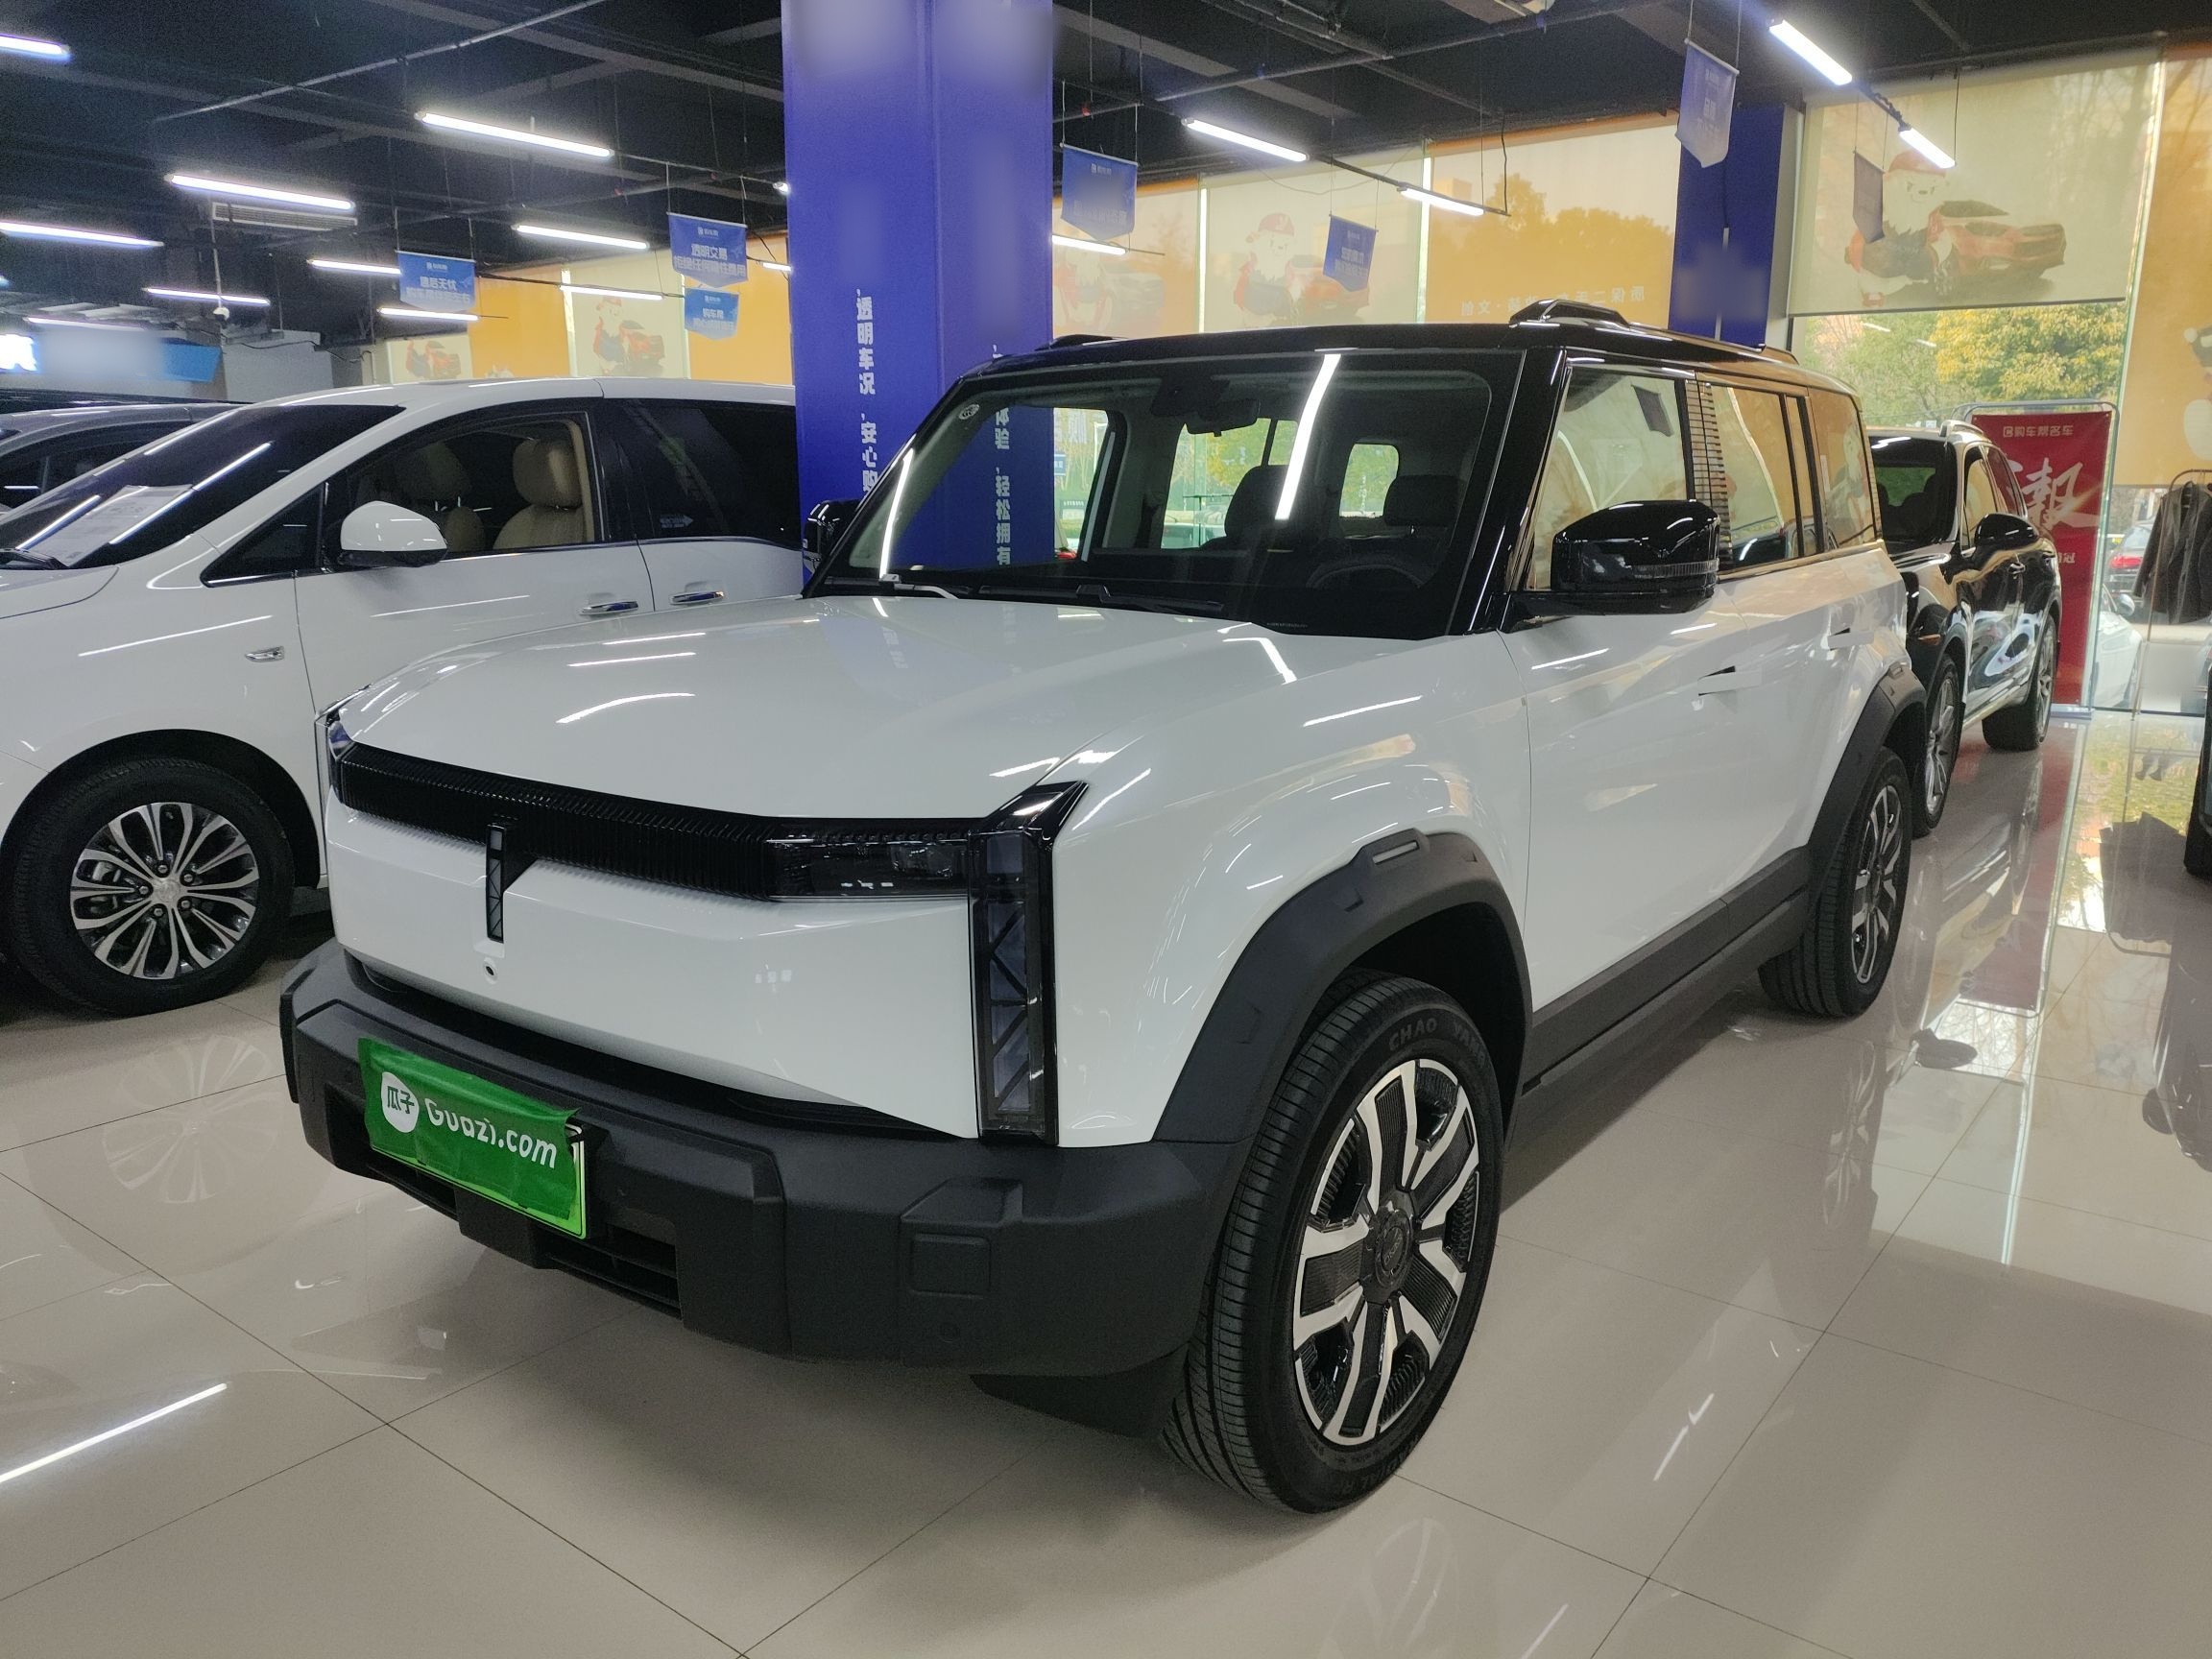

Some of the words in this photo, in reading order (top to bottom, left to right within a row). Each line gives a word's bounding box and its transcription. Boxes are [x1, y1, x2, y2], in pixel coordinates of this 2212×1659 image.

[691, 243, 728, 260] 透明交易
[1389, 1018, 1438, 1051] CHAO
[386, 1085, 415, 1115] 瓜子
[424, 1097, 558, 1169] Guazi.com
